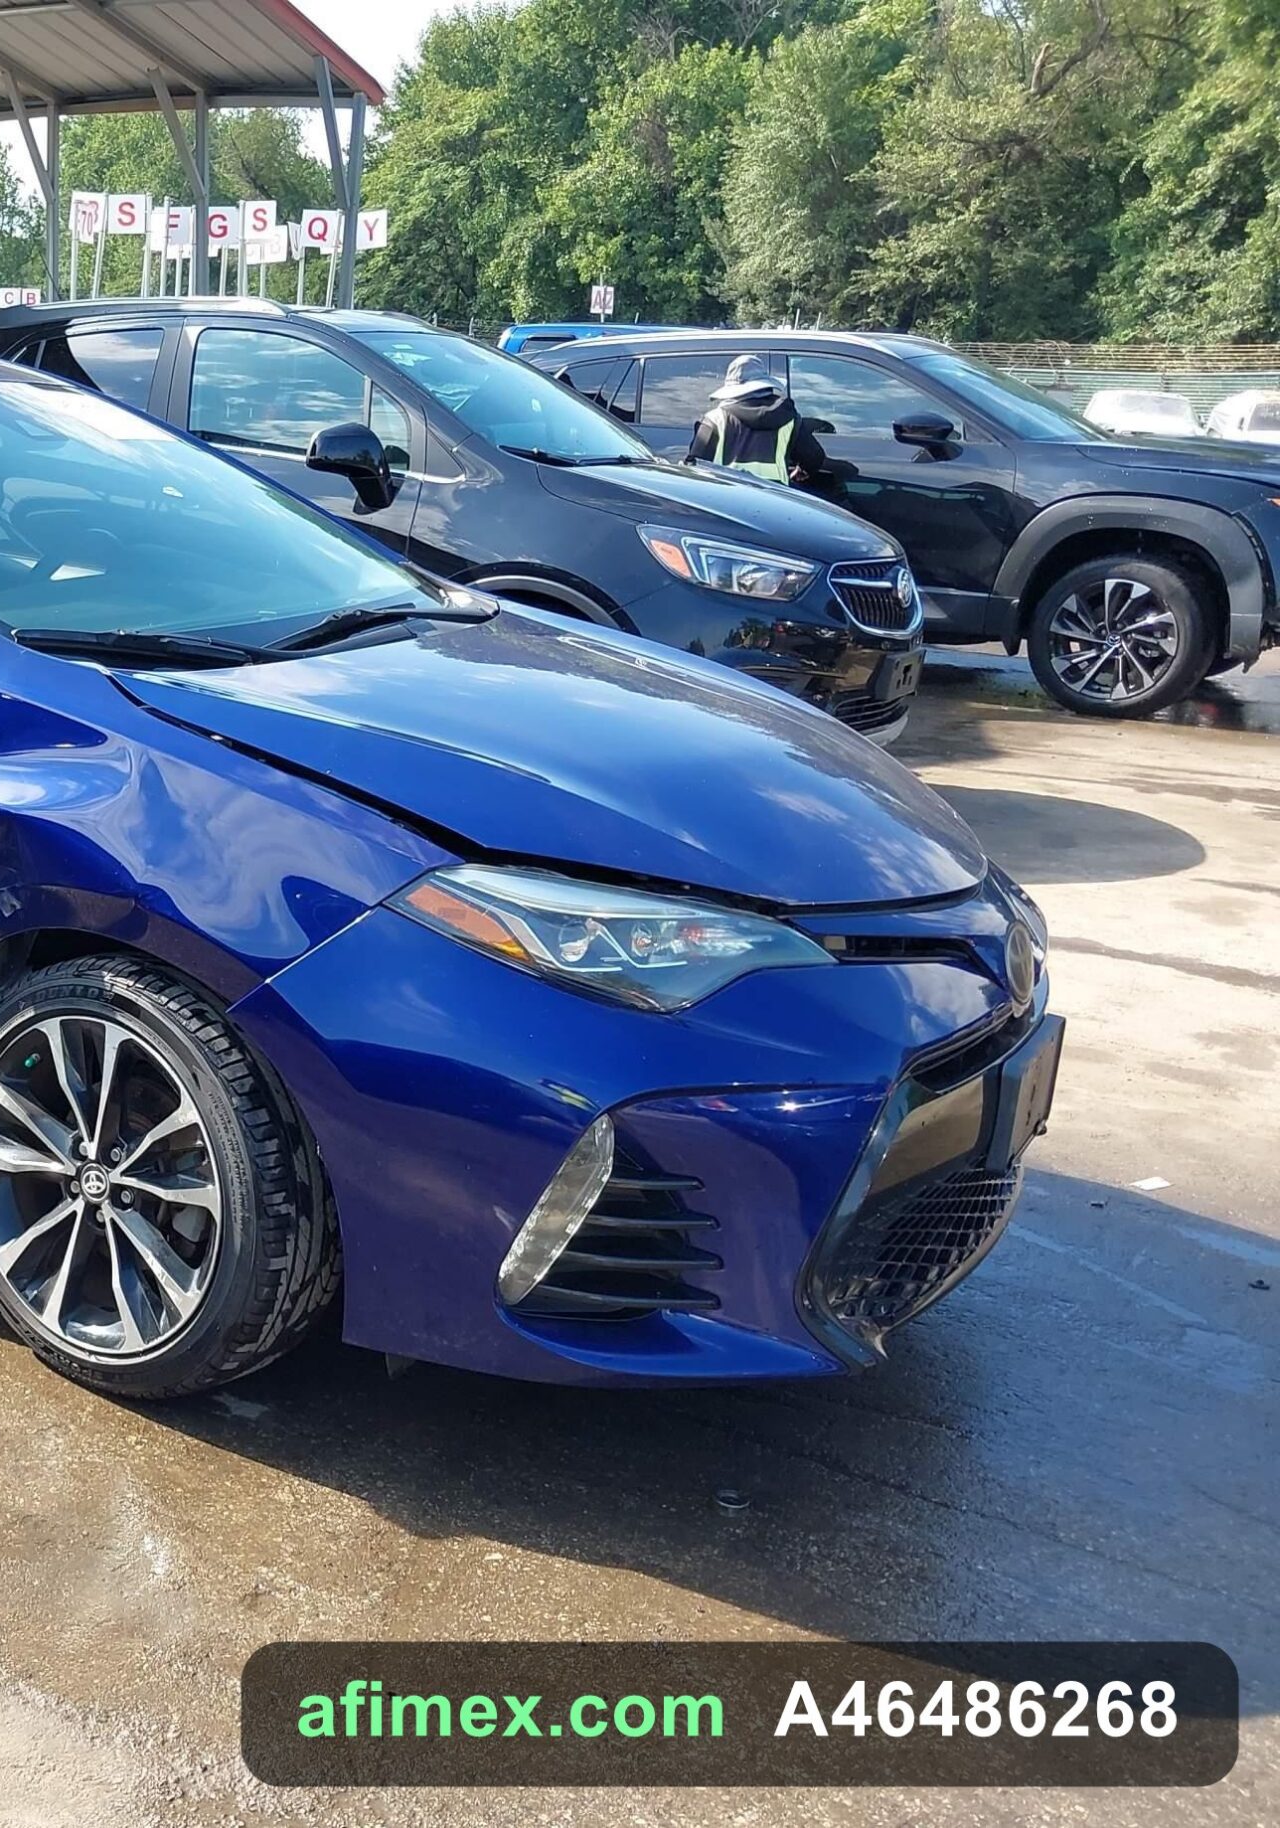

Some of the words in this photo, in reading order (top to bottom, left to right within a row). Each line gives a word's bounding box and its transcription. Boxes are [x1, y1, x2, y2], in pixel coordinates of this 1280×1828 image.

[117, 202, 136, 226] S
[207, 214, 228, 238] G
[252, 208, 268, 232] S
[308, 217, 328, 242] Q
[364, 218, 380, 241] Y
[4, 291, 15, 304] C
[26, 292, 37, 305] B
